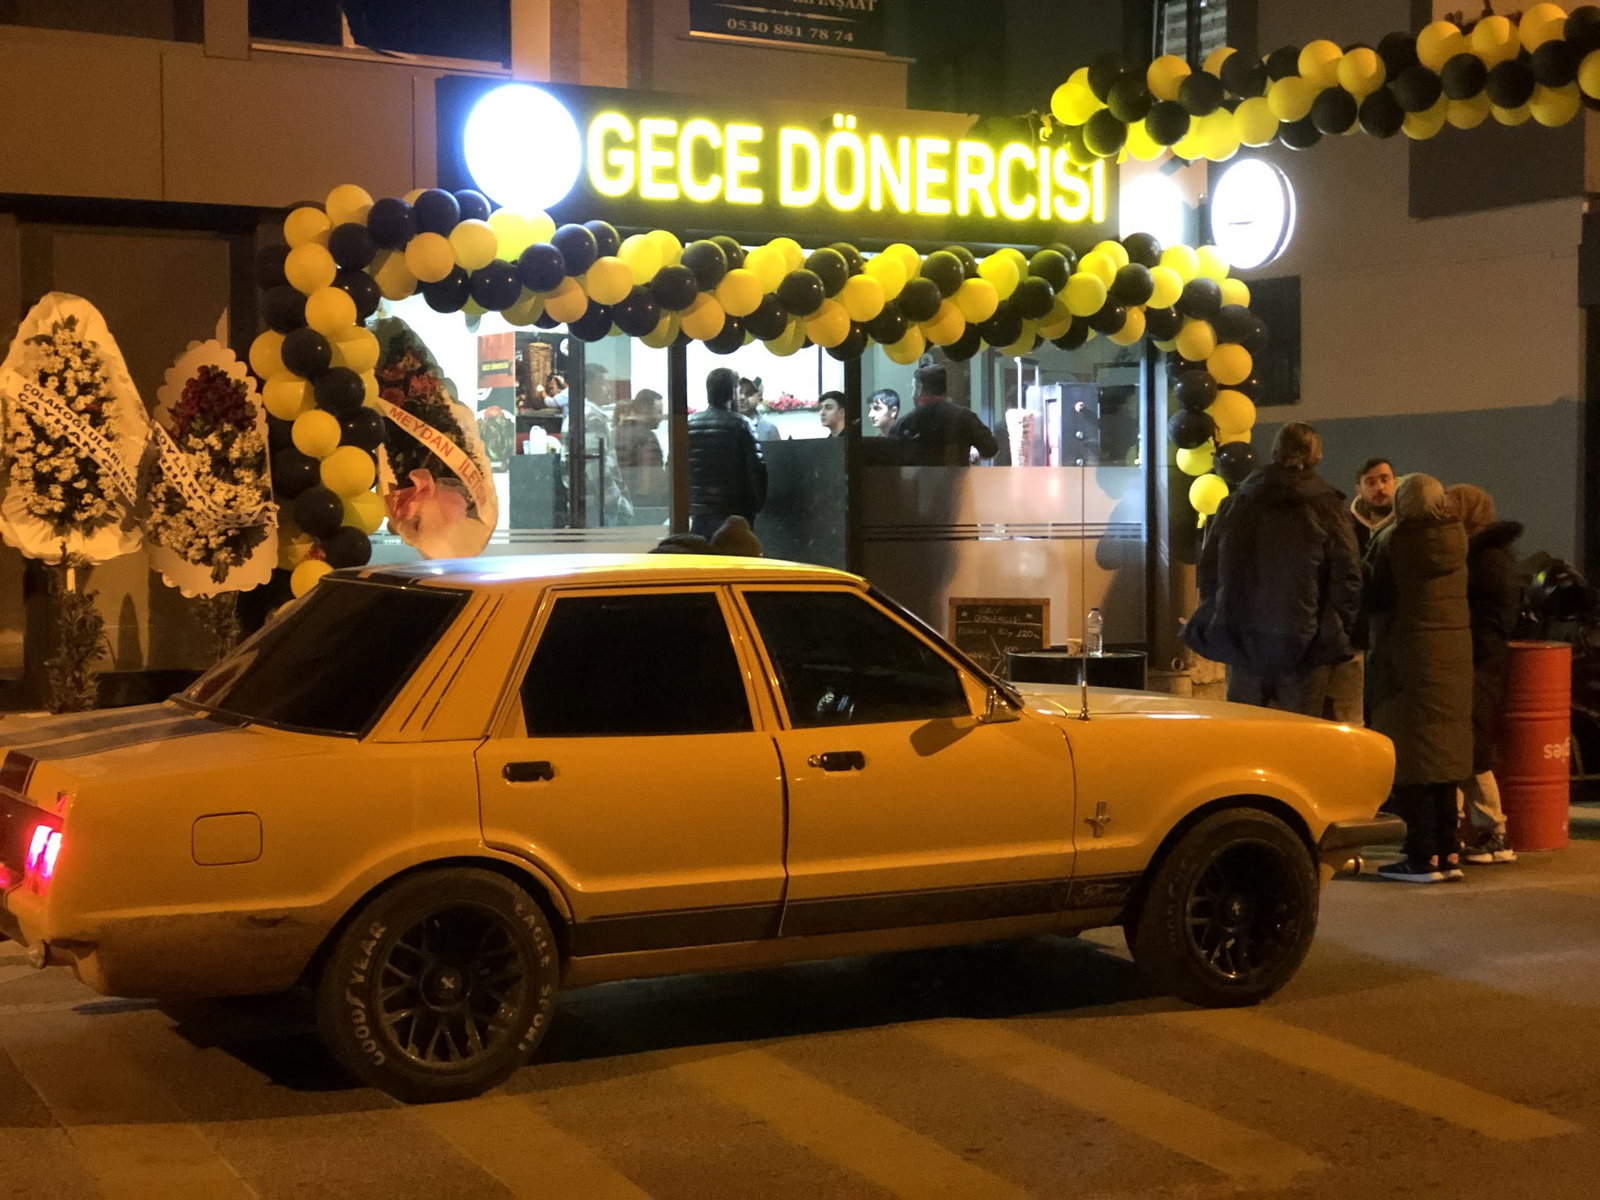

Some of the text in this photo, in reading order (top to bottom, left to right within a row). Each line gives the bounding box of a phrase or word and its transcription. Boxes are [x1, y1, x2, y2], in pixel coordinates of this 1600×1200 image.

[726, 18, 854, 43] 0530 881 78 74
[586, 110, 763, 206] GECE
[388, 406, 454, 458] MEYDAN
